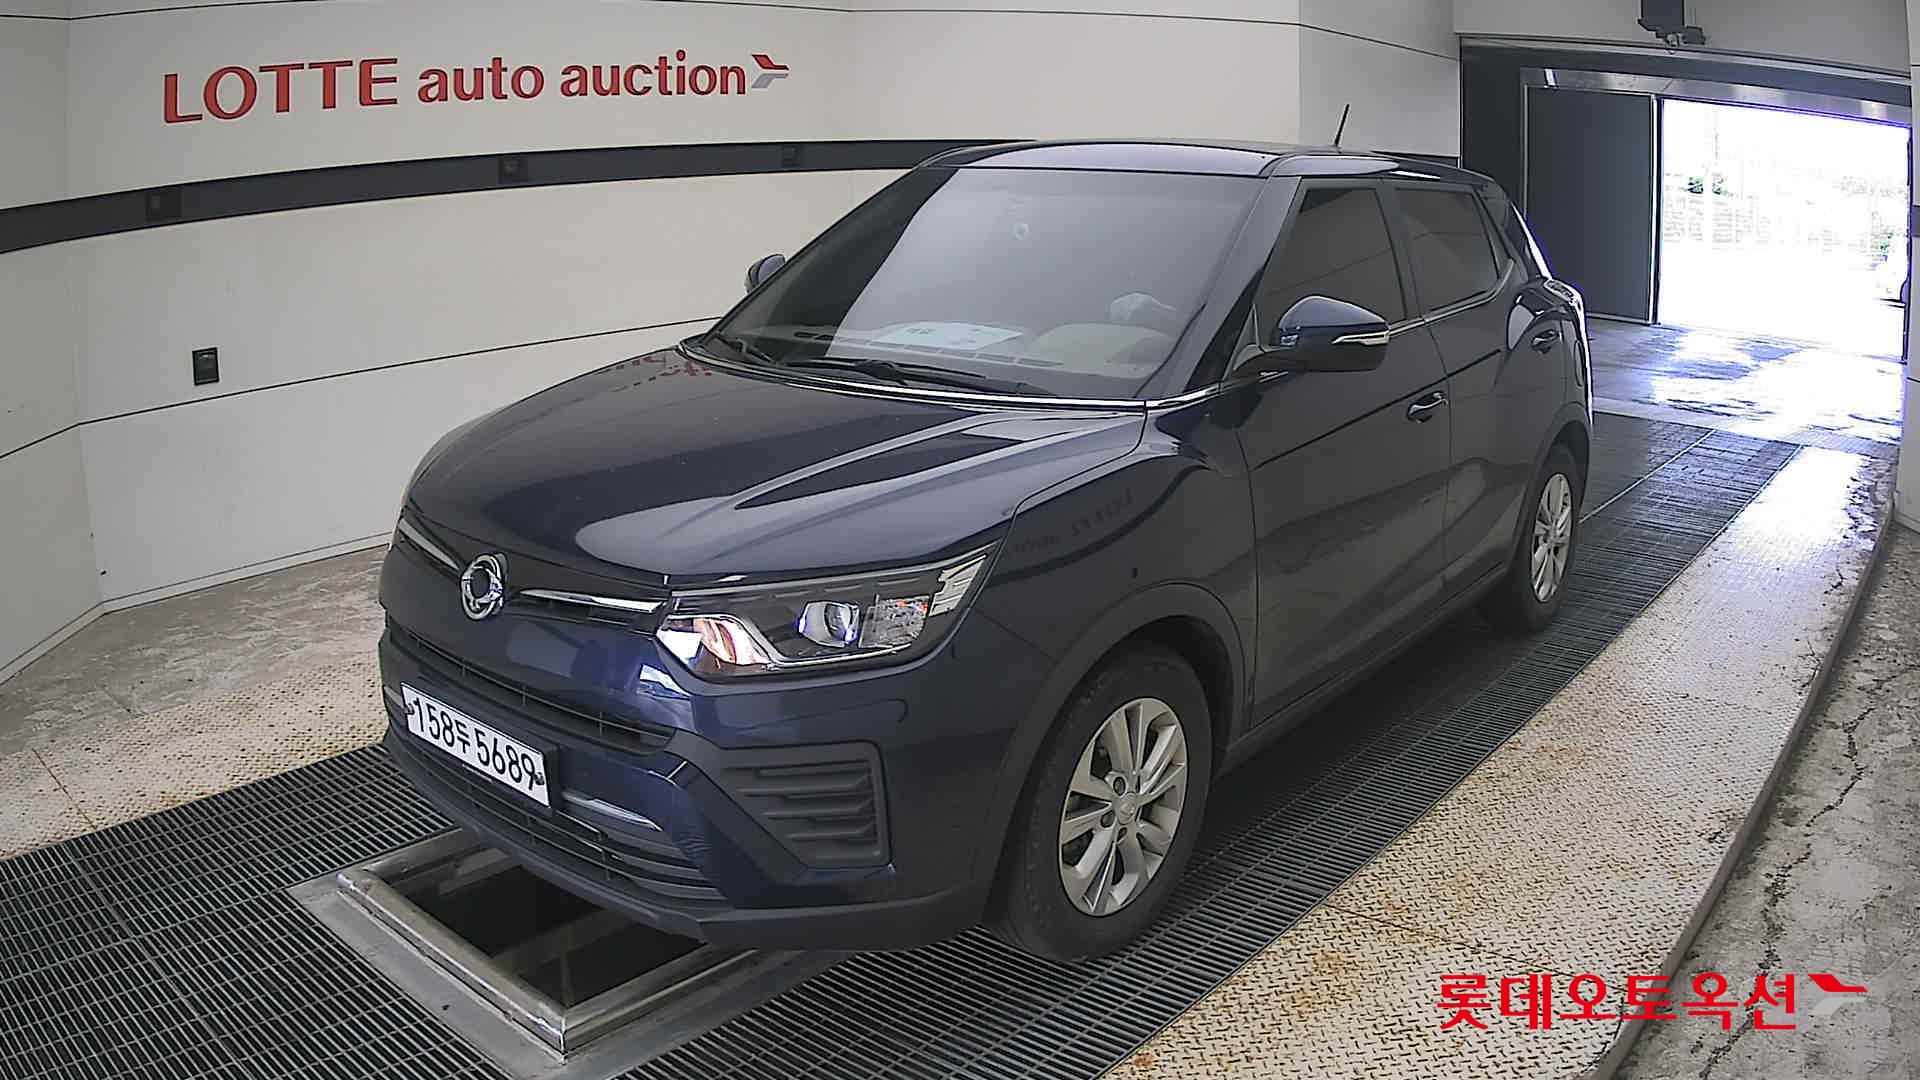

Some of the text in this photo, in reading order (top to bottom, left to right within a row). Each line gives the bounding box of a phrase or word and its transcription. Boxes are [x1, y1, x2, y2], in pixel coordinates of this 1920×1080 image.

[163, 49, 747, 123] LOTTE auto auction
